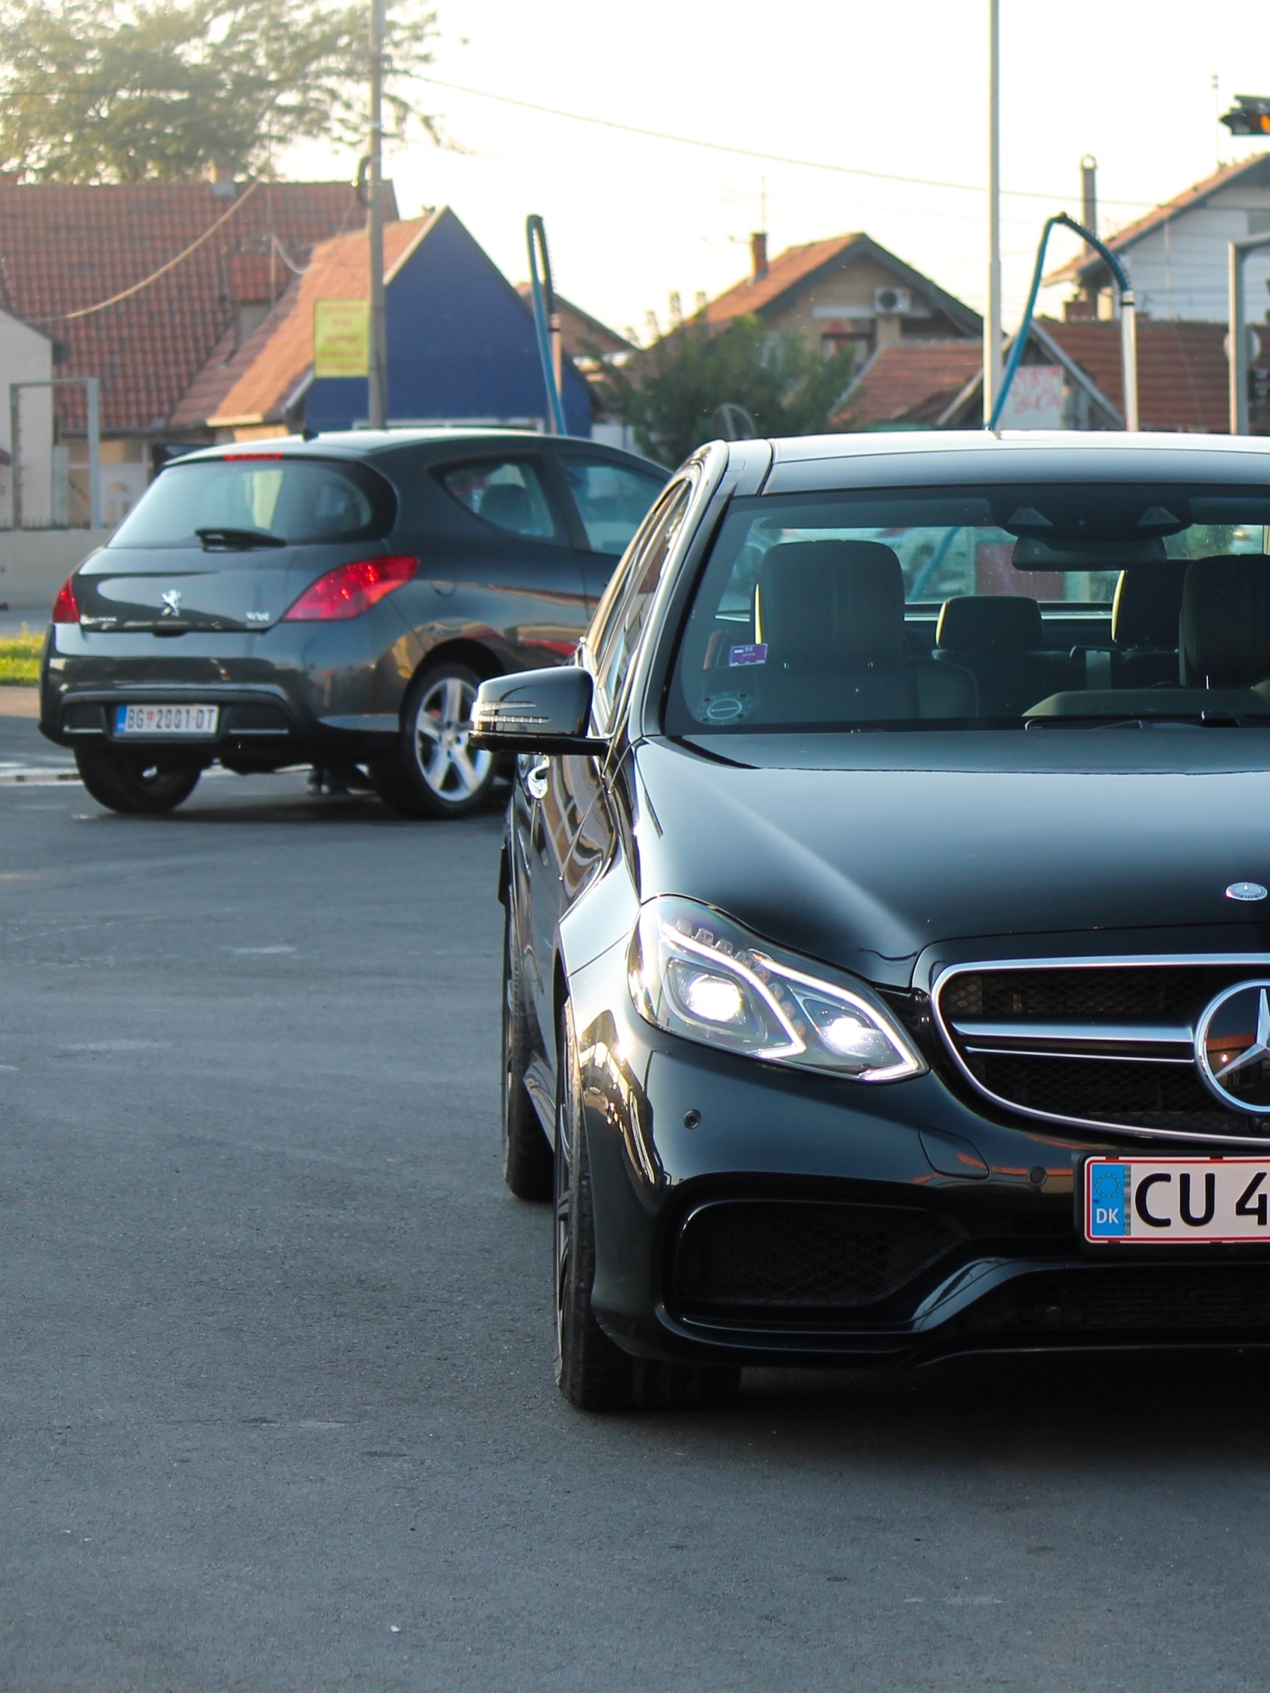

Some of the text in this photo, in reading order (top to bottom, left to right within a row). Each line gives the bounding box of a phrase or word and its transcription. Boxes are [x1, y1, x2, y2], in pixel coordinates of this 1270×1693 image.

[127, 709, 144, 729] BG
[1135, 1173, 1215, 1227] CU
[1096, 1208, 1119, 1224] DK
